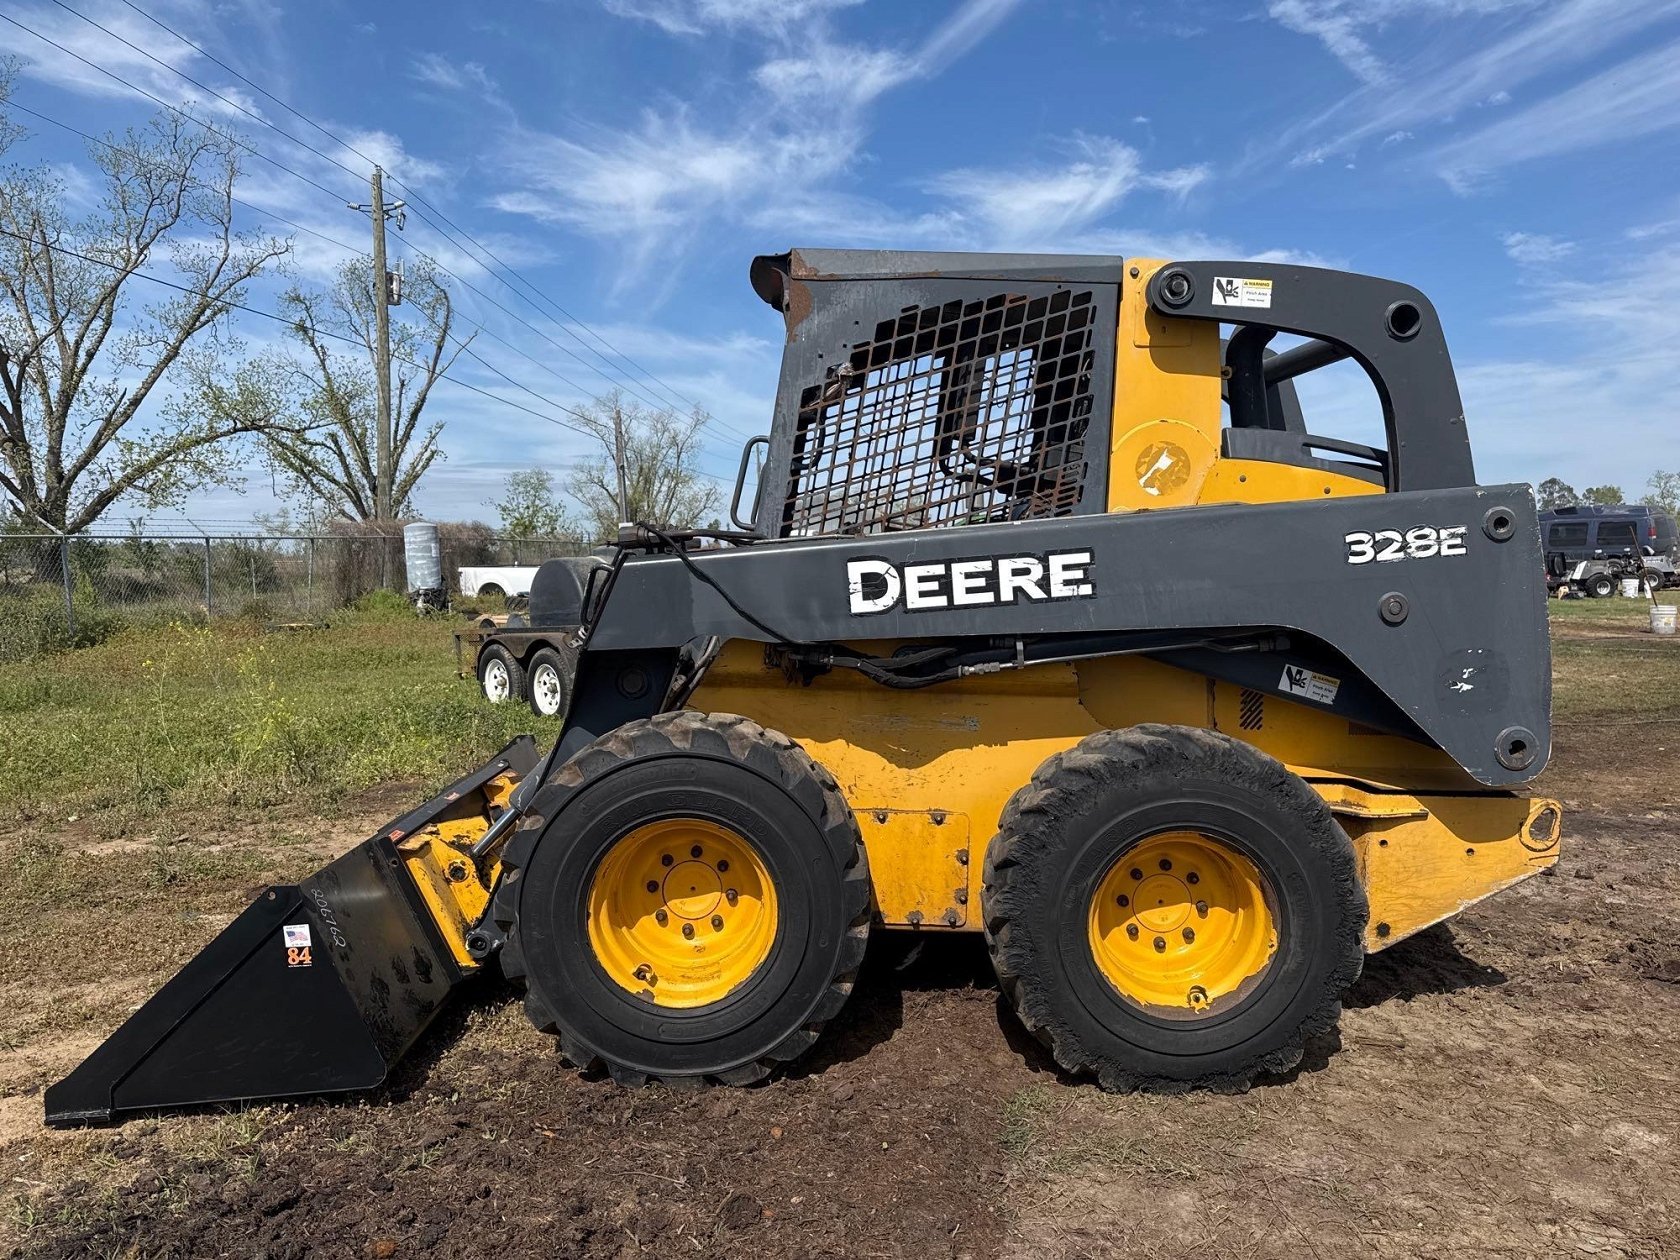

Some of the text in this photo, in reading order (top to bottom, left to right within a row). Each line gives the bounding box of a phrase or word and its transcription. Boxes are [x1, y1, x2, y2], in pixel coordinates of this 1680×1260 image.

[1345, 525, 1467, 564] 328E
[847, 552, 1093, 614] DEERE
[311, 888, 346, 947] 206762
[288, 947, 312, 964] 84
